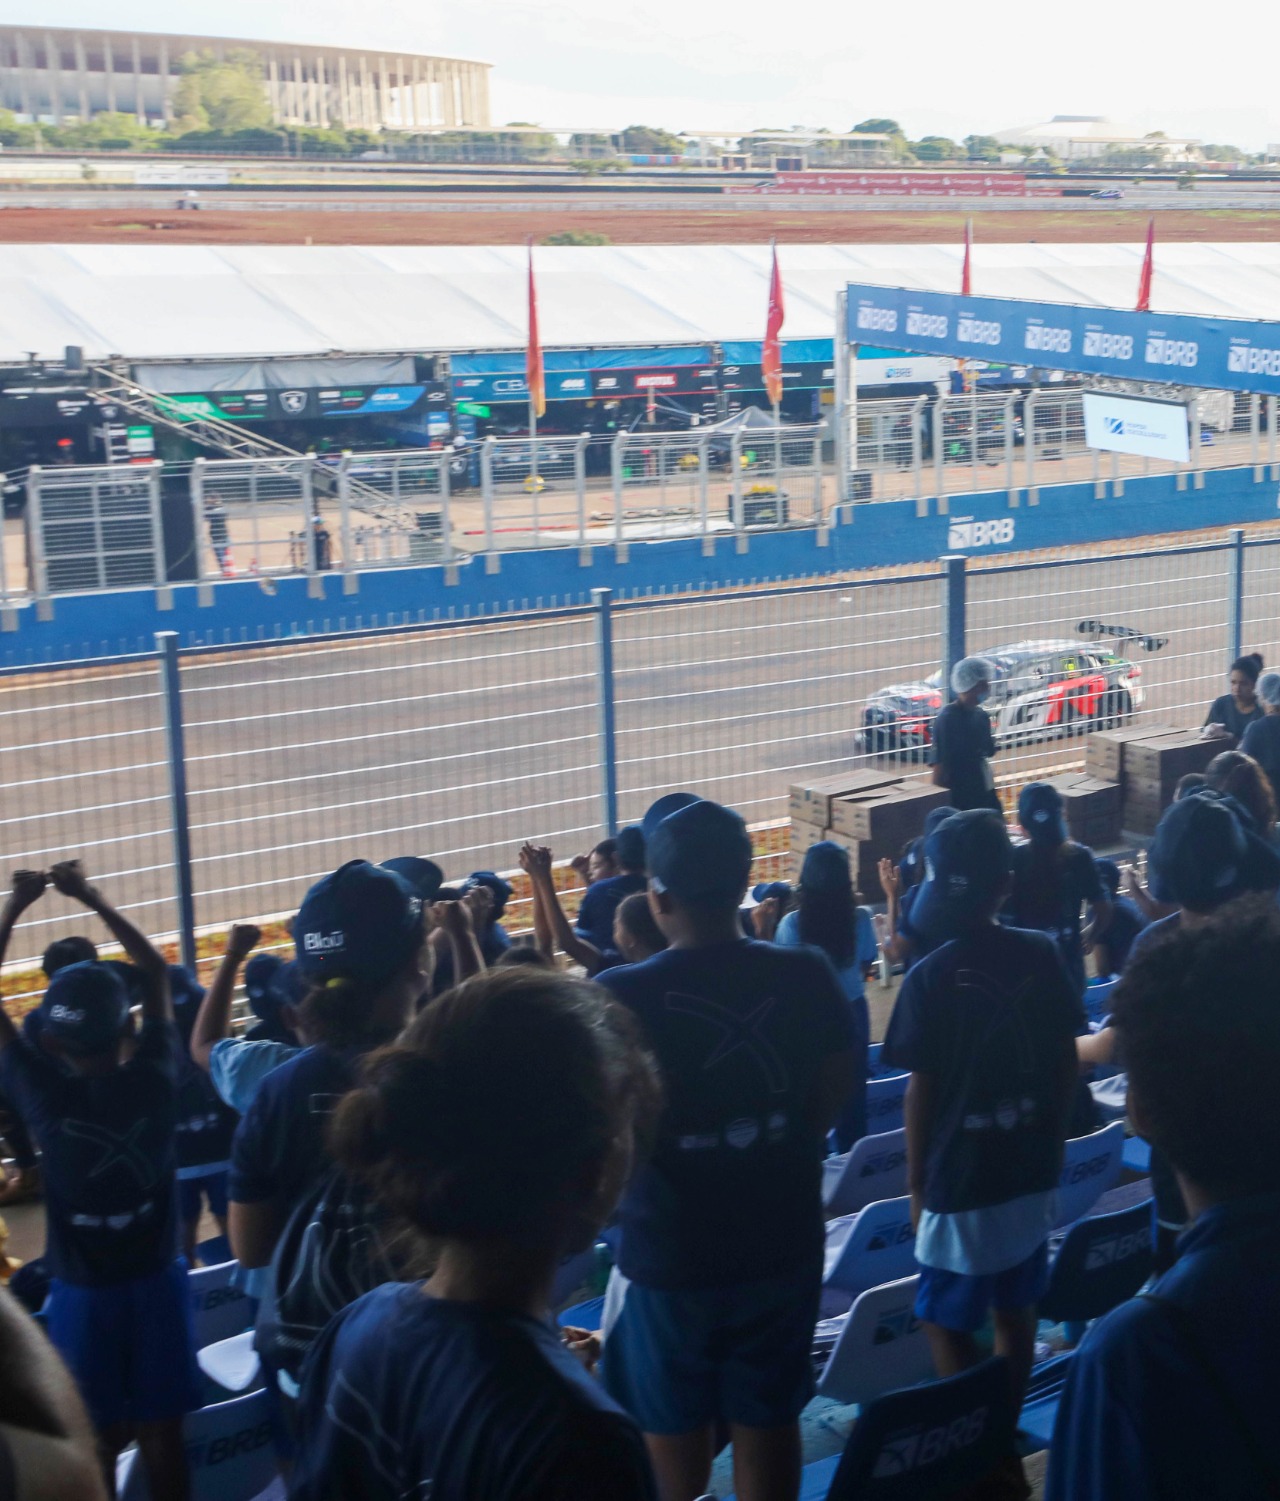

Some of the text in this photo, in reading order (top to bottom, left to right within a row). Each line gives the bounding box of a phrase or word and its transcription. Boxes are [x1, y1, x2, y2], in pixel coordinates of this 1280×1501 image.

[1101, 334, 1133, 360] BRB
[1164, 340, 1199, 367] BRB
[492, 380, 530, 392] CB
[972, 518, 1015, 547] BRB
[1069, 1151, 1112, 1185] BRB
[913, 1406, 990, 1464] BRB
